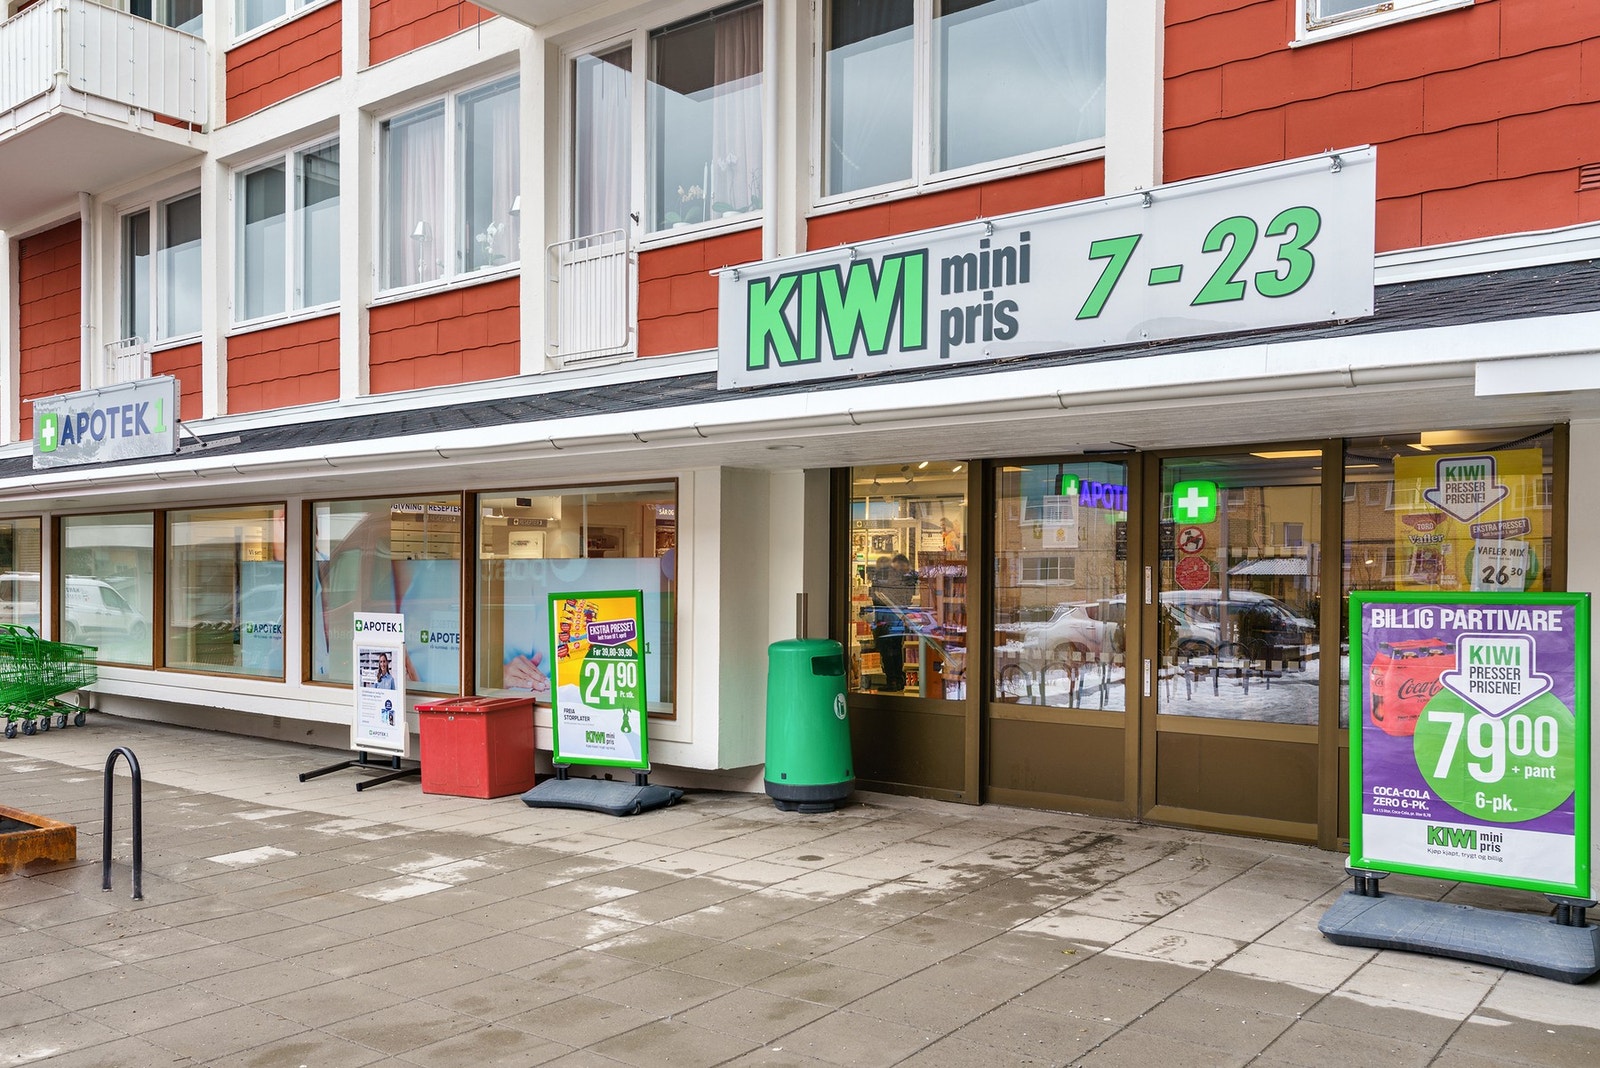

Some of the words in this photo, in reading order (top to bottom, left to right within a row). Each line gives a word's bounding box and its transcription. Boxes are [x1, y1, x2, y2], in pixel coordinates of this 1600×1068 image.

[940, 231, 1031, 295] mini
[1075, 234, 1142, 320] 7
[1148, 264, 1183, 286] -
[1190, 206, 1321, 306] 23
[746, 248, 928, 371] KIWI
[940, 290, 1019, 358] pris
[61, 401, 150, 445] APOTEK
[154, 397, 167, 433] 1
[1445, 464, 1485, 482] KIWI
[1445, 482, 1486, 494] PRESSER
[1445, 493, 1486, 504] PRISENE!
[1473, 524, 1497, 534] EKSTRA
[1499, 520, 1526, 531] PRESSET
[1408, 533, 1444, 544] Vafler
[1478, 546, 1507, 556] VAFLER
[1509, 548, 1525, 557] MIX
[1482, 565, 1510, 585] 26
[1510, 567, 1523, 576] 30
[363, 621, 397, 632] APOTEK
[398, 623, 403, 632] 1
[1371, 608, 1434, 629] BILLIG
[1441, 609, 1562, 631] PARTIVARE
[253, 623, 282, 633] APOTEK
[590, 624, 610, 635] EKSTRA
[610, 621, 633, 633] PRESSET
[645, 641, 652, 654] 1
[1469, 645, 1520, 666] KIWI
[1469, 666, 1520, 681] PRESSER
[1469, 680, 1521, 695] PRISENE!
[585, 730, 606, 744] KIWI
[1428, 711, 1506, 784] 79
[1524, 765, 1556, 779] pant
[1373, 786, 1430, 799] COCA-COLA
[1373, 796, 1400, 807] ZERO
[1401, 799, 1429, 810] 6-PK.
[1475, 791, 1518, 812] 6-pk.
[1427, 825, 1477, 850] KIWI
[1480, 831, 1503, 843] mini
[1480, 842, 1501, 853] pris
[1461, 852, 1477, 860] trygt
